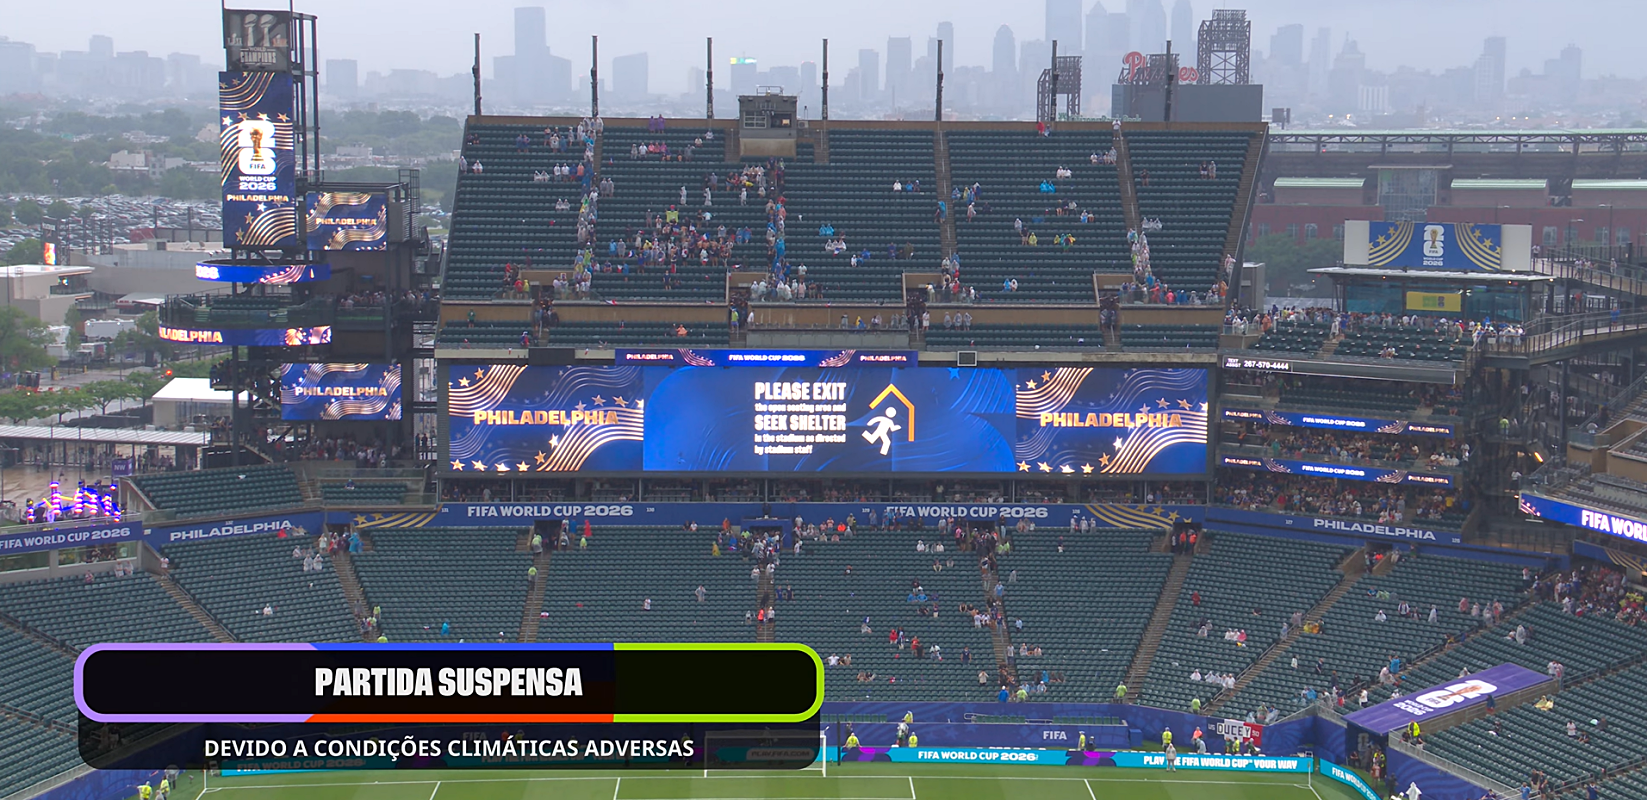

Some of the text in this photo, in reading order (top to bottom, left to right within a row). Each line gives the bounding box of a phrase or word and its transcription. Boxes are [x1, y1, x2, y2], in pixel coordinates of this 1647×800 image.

[240, 52, 277, 64] CHAMPIONS
[239, 182, 278, 190] 2026
[315, 218, 377, 226] PHILADELPHIA
[1243, 360, 1289, 370] 267-570-4444
[295, 387, 388, 396] PHILADELPHIA
[754, 382, 847, 400] PLEASE EXIT
[754, 402, 768, 412] the
[768, 404, 786, 413] open
[786, 402, 814, 413] seating
[832, 402, 847, 412] and
[473, 410, 618, 425] PHILADELPHIA
[754, 414, 847, 431] SEEK SHELTER
[1040, 412, 1183, 428] PHILADELPHIA
[1408, 426, 1450, 434] PHILADELPHIA
[762, 434, 775, 442] the
[776, 434, 805, 442] stadium
[805, 434, 815, 442] as
[815, 434, 846, 442] directed
[754, 445, 813, 456] by stadium staff
[1224, 458, 1262, 466] PHILADELPHIA
[1407, 475, 1450, 483] PHILADELPHIA
[467, 506, 634, 516] FIFA WORLD CUP 2026
[918, 506, 966, 517] WORLD
[969, 507, 997, 518] CUP
[999, 507, 1047, 518] 2026
[1582, 510, 1611, 532] FIFA
[170, 520, 293, 541] PHILADELPHIA
[1314, 518, 1436, 540] PHILADELPHIA
[24, 534, 66, 546] WORLD
[67, 532, 90, 542] CUP
[91, 528, 130, 540] 2026
[1042, 730, 1067, 740] FIFA
[1218, 724, 1250, 737] DUCEY
[918, 751, 1035, 762] FIFA WORLD CUP 2026
[262, 762, 301, 770] WORLD
[303, 760, 324, 769] CUP
[1144, 756, 1165, 766] PLAY
[1182, 757, 1200, 767] FIFA
[1201, 758, 1230, 768] WORLD
[1254, 760, 1277, 770] YOUR
[1278, 760, 1298, 772] WAY
[1332, 767, 1345, 779] FIFA
